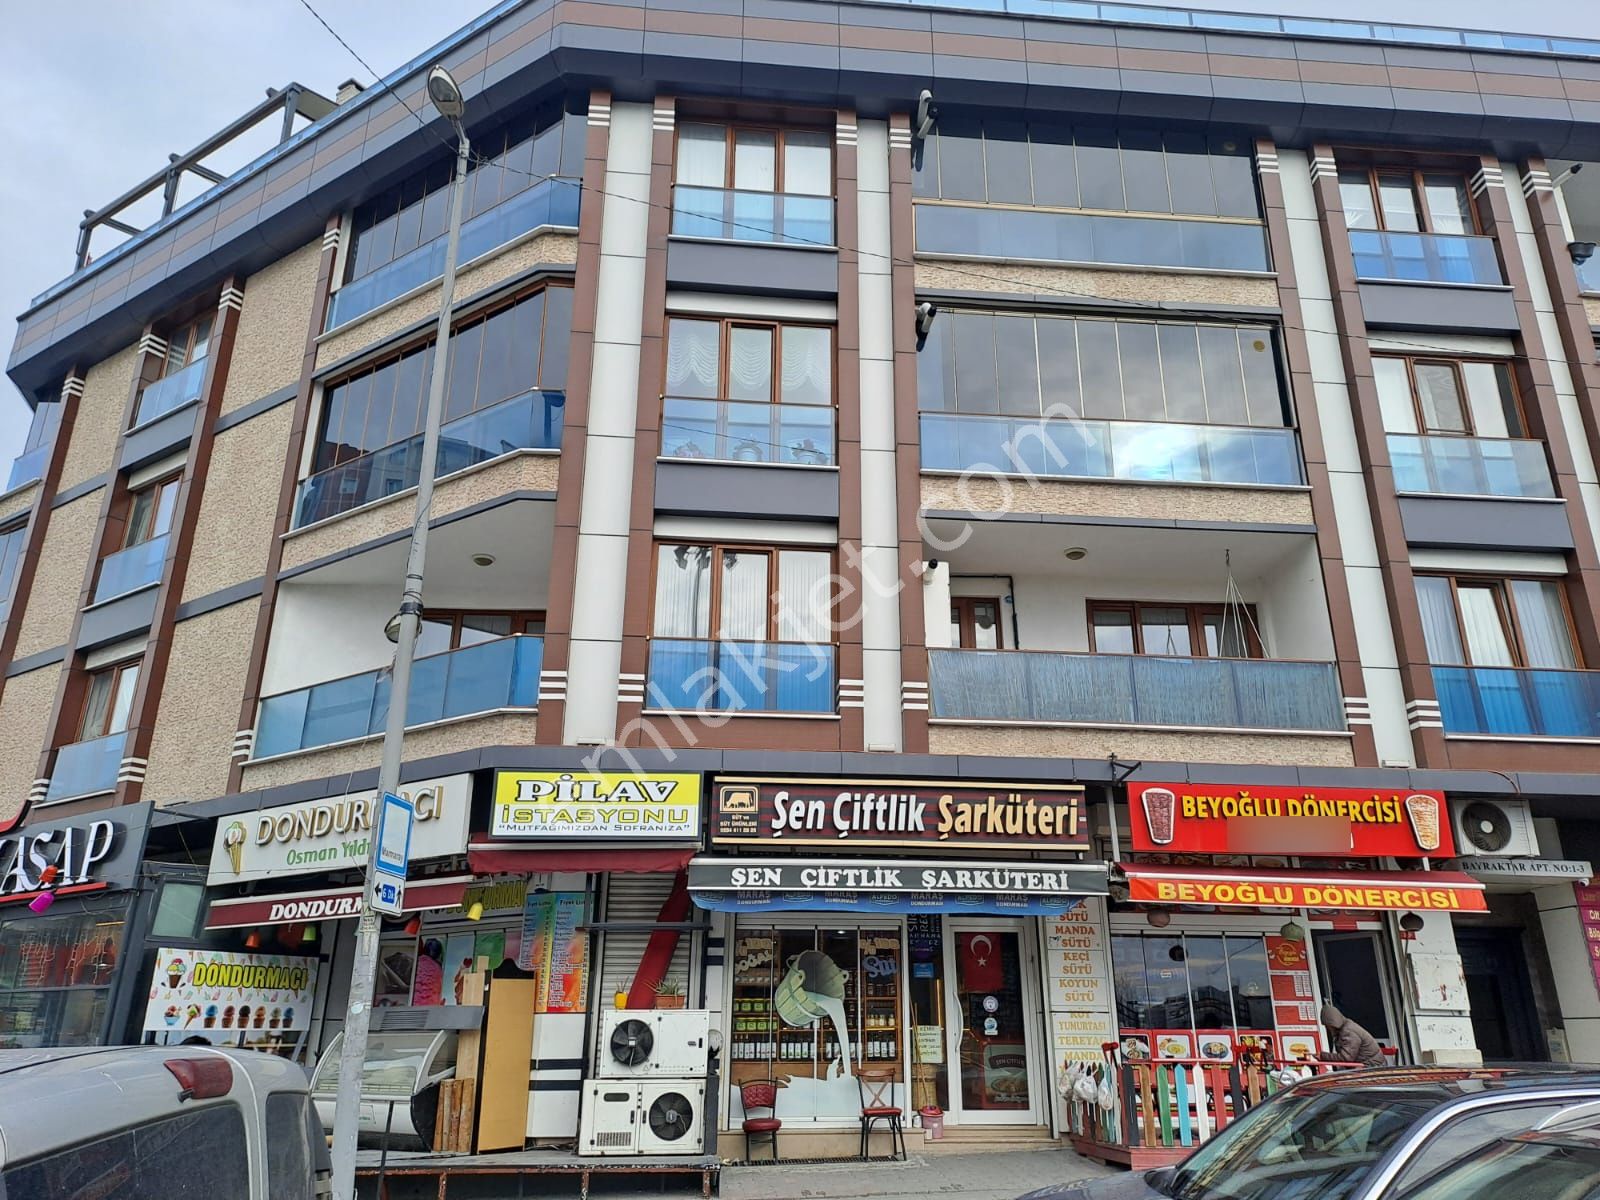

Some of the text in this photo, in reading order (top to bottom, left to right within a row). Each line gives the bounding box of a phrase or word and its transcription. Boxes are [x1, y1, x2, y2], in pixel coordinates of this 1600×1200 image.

[516, 774, 679, 803] PİLAV
[256, 786, 443, 846] DONDURCI
[501, 804, 688, 824] İSTASYONU
[771, 791, 1078, 841] Şen Çiftlik Şarküteri
[1182, 790, 1402, 824] BEYOĞLU DÖNERCİSİ
[0, 820, 114, 894] ASAP
[286, 846, 338, 866] Osman
[1462, 861, 1586, 873] BAYRAKTAR APT. NO:1-3
[731, 866, 1070, 891] ŞEN ÇİFTLİK ŞARKÜTERİ
[1158, 881, 1459, 909] BEYOĞLU DÖNERCİSİ
[269, 896, 364, 921] DONDURM
[1055, 925, 1095, 936] MANDA
[1061, 936, 1091, 948] SÜTÜ
[1063, 950, 1090, 963] KEÇİ
[192, 962, 309, 991] DONDURMACI
[1062, 963, 1093, 975] SÜTÜ
[1059, 979, 1098, 989] KOYUN
[1064, 991, 1095, 1002] SÜTÜ
[1058, 1021, 1106, 1031] YUMURTASI
[1058, 1036, 1104, 1046] TEREYA
